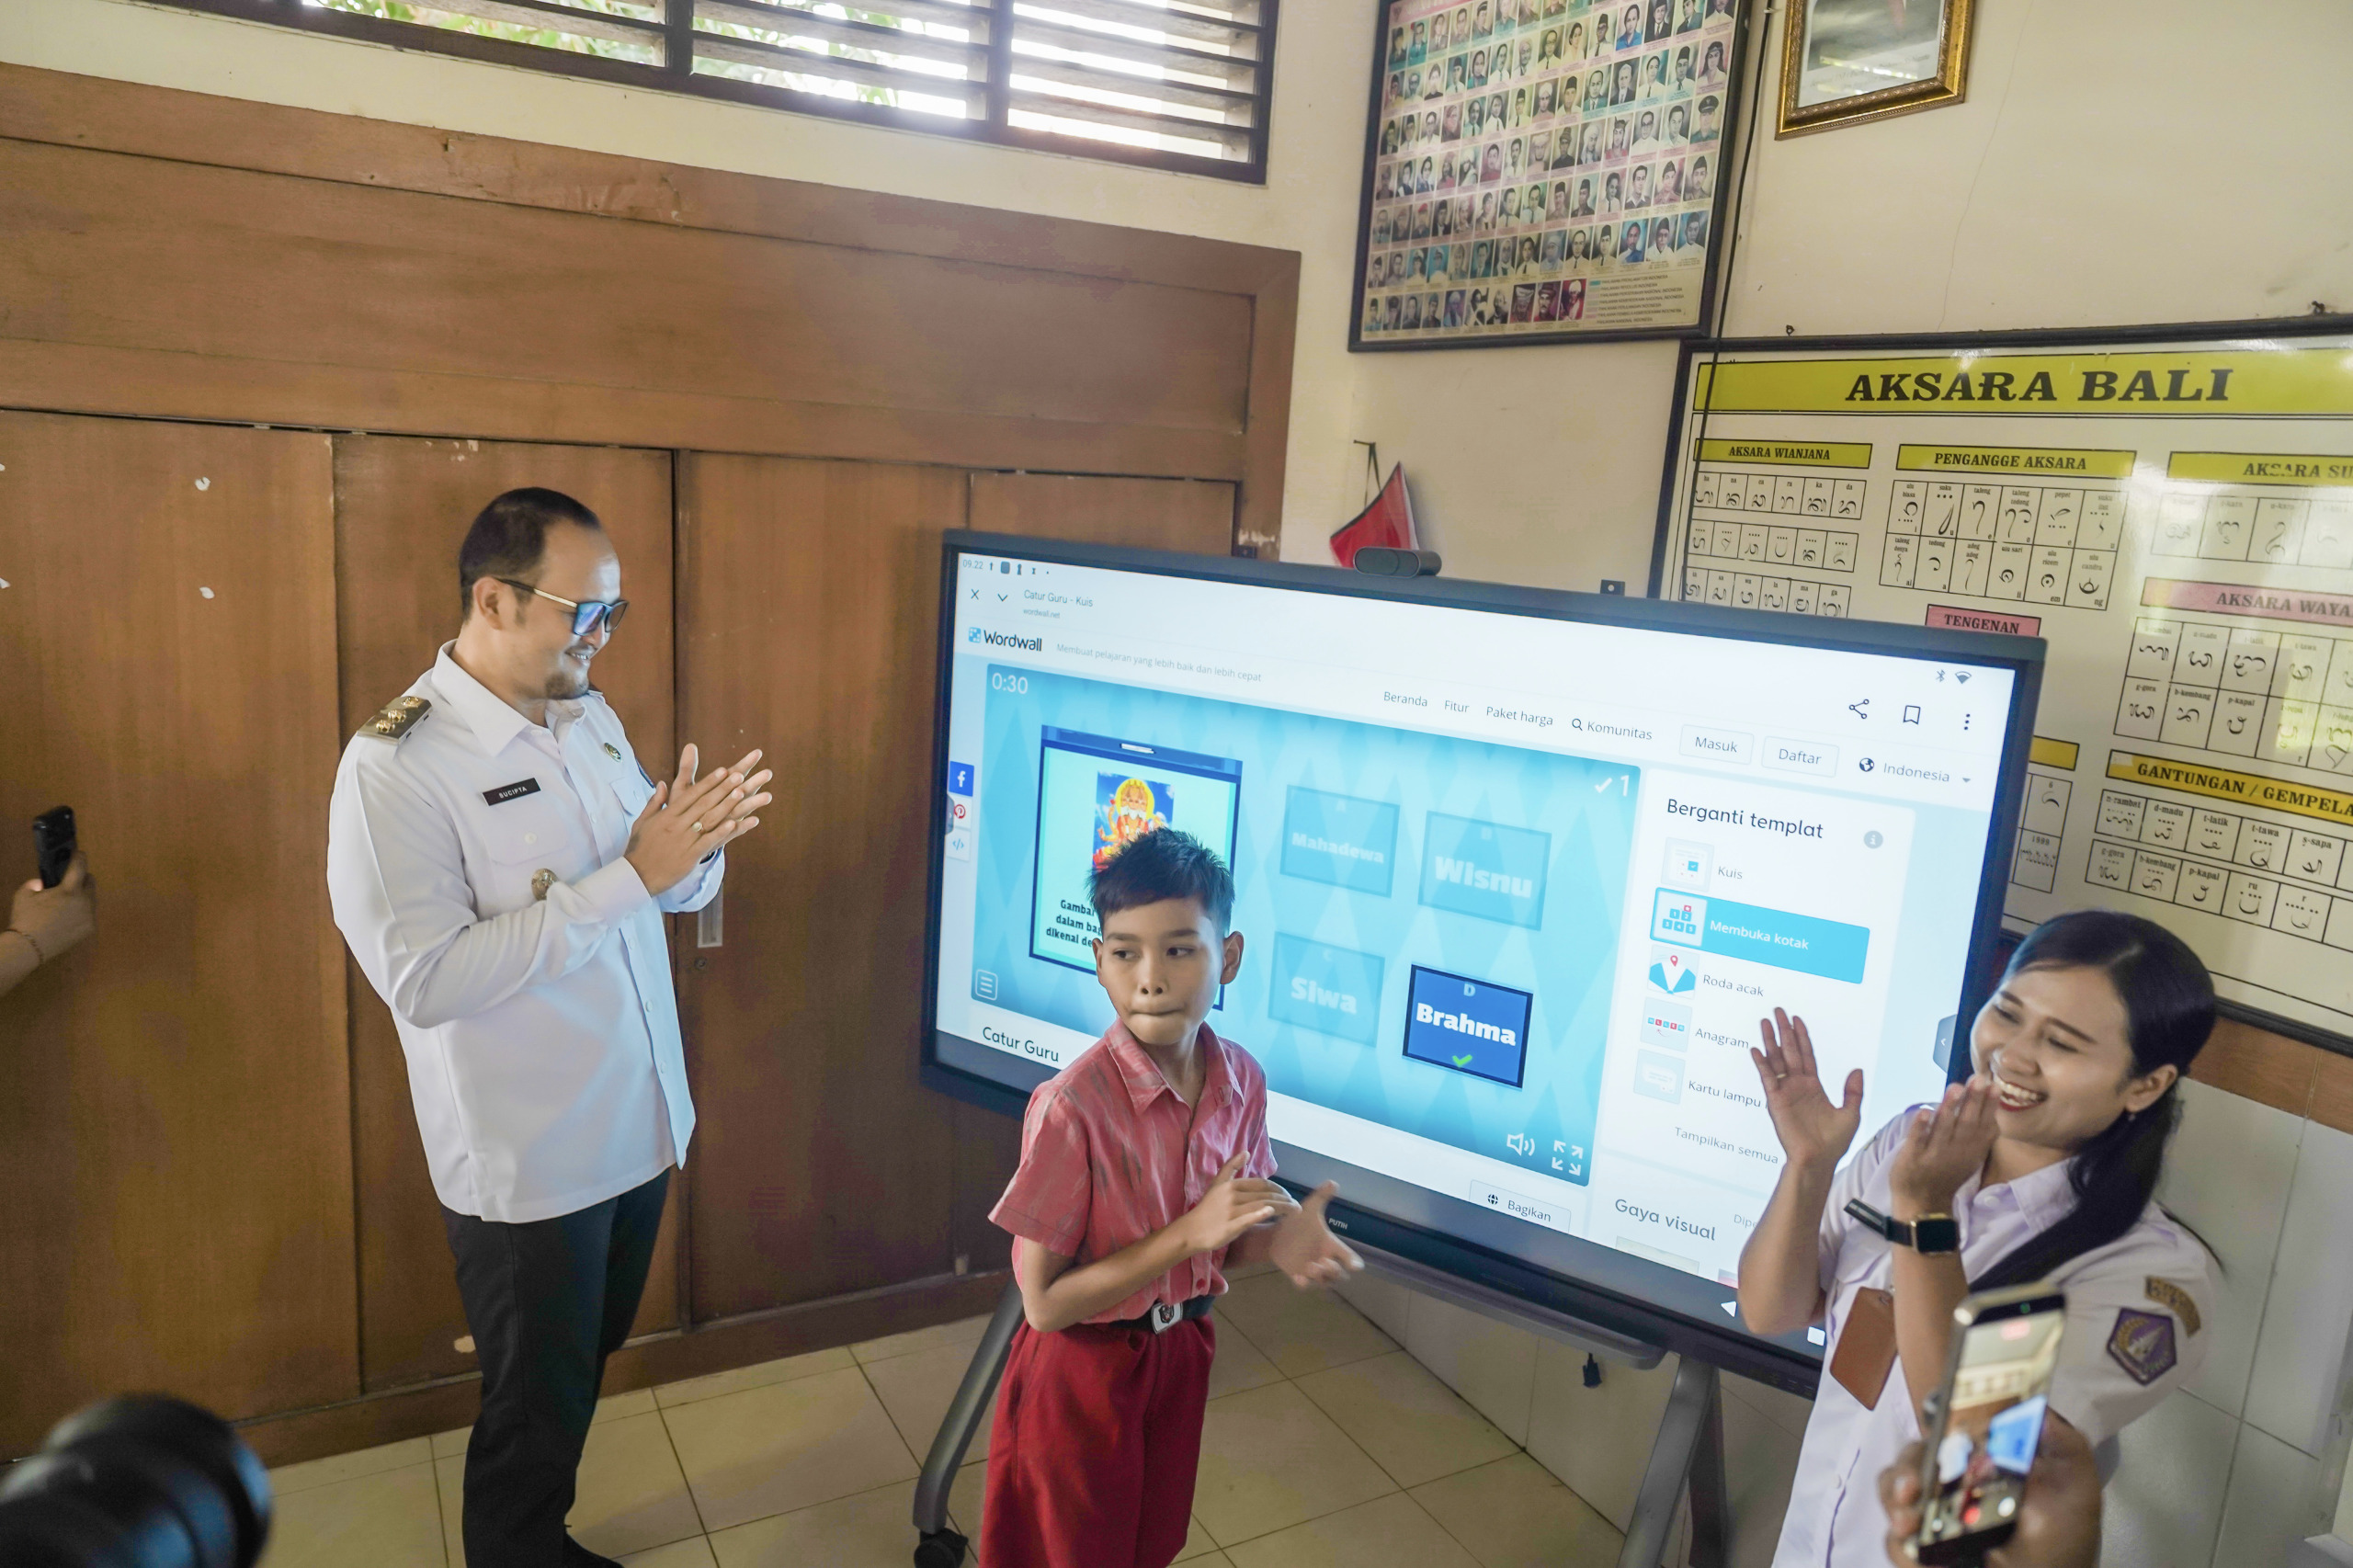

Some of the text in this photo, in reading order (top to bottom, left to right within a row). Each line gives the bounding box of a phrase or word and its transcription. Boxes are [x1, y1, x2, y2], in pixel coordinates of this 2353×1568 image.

[1845, 369, 2234, 403] AKSARA BALI
[1729, 446, 1831, 460] AKSARA WIANJANA
[1934, 452, 2087, 471] PENGANGGE AKSARA
[1023, 589, 1046, 601] Catur
[1048, 593, 1068, 604] Guru
[1075, 597, 1094, 608] Kuis
[2216, 592, 2291, 611] AKSARA
[1943, 614, 2020, 635] TENGENAN
[983, 629, 1042, 652] Wordwall
[1057, 643, 1262, 683] Membuat pelajaran yang lebih baik dan lebih cepat
[992, 672, 1029, 695] 0:30
[2227, 696, 2256, 708] p-kapal
[1383, 690, 1653, 741] Beranda Fitur Paket harga Komunitas
[1694, 736, 1738, 754] Masuk
[1778, 748, 1822, 766] Daftar
[1883, 763, 1950, 783] Indonesia
[498, 786, 528, 799] SUCIPTA
[1620, 775, 1630, 797] 1
[2138, 763, 2353, 817] GANTUNGAN / GEMPELA
[1667, 799, 1824, 839] Berganti templat
[2154, 803, 2184, 817] d-madu
[1291, 832, 1384, 865] Mahadewa
[1434, 856, 1533, 899] Wisnu
[1718, 866, 1744, 881] Kuis
[2188, 867, 2221, 881] p-kapal
[1046, 927, 1079, 945] dikenal
[1055, 914, 1102, 937] dalam bag
[1710, 919, 1810, 950] Membuka kotak
[1291, 977, 1358, 1015] Siwa
[1463, 983, 1476, 998] D
[1702, 974, 1765, 997] Roda acak
[1415, 1002, 1517, 1047] Brahma
[983, 1027, 1059, 1062] Catur Guru
[1695, 1028, 1750, 1050] Anagram
[1688, 1080, 1721, 1096] Kartu
[1723, 1088, 1761, 1108] lampu
[1674, 1127, 1779, 1165] Tampilkan semua
[1507, 1199, 1552, 1222] Bagikan
[1615, 1199, 1716, 1242] Gaya visual
